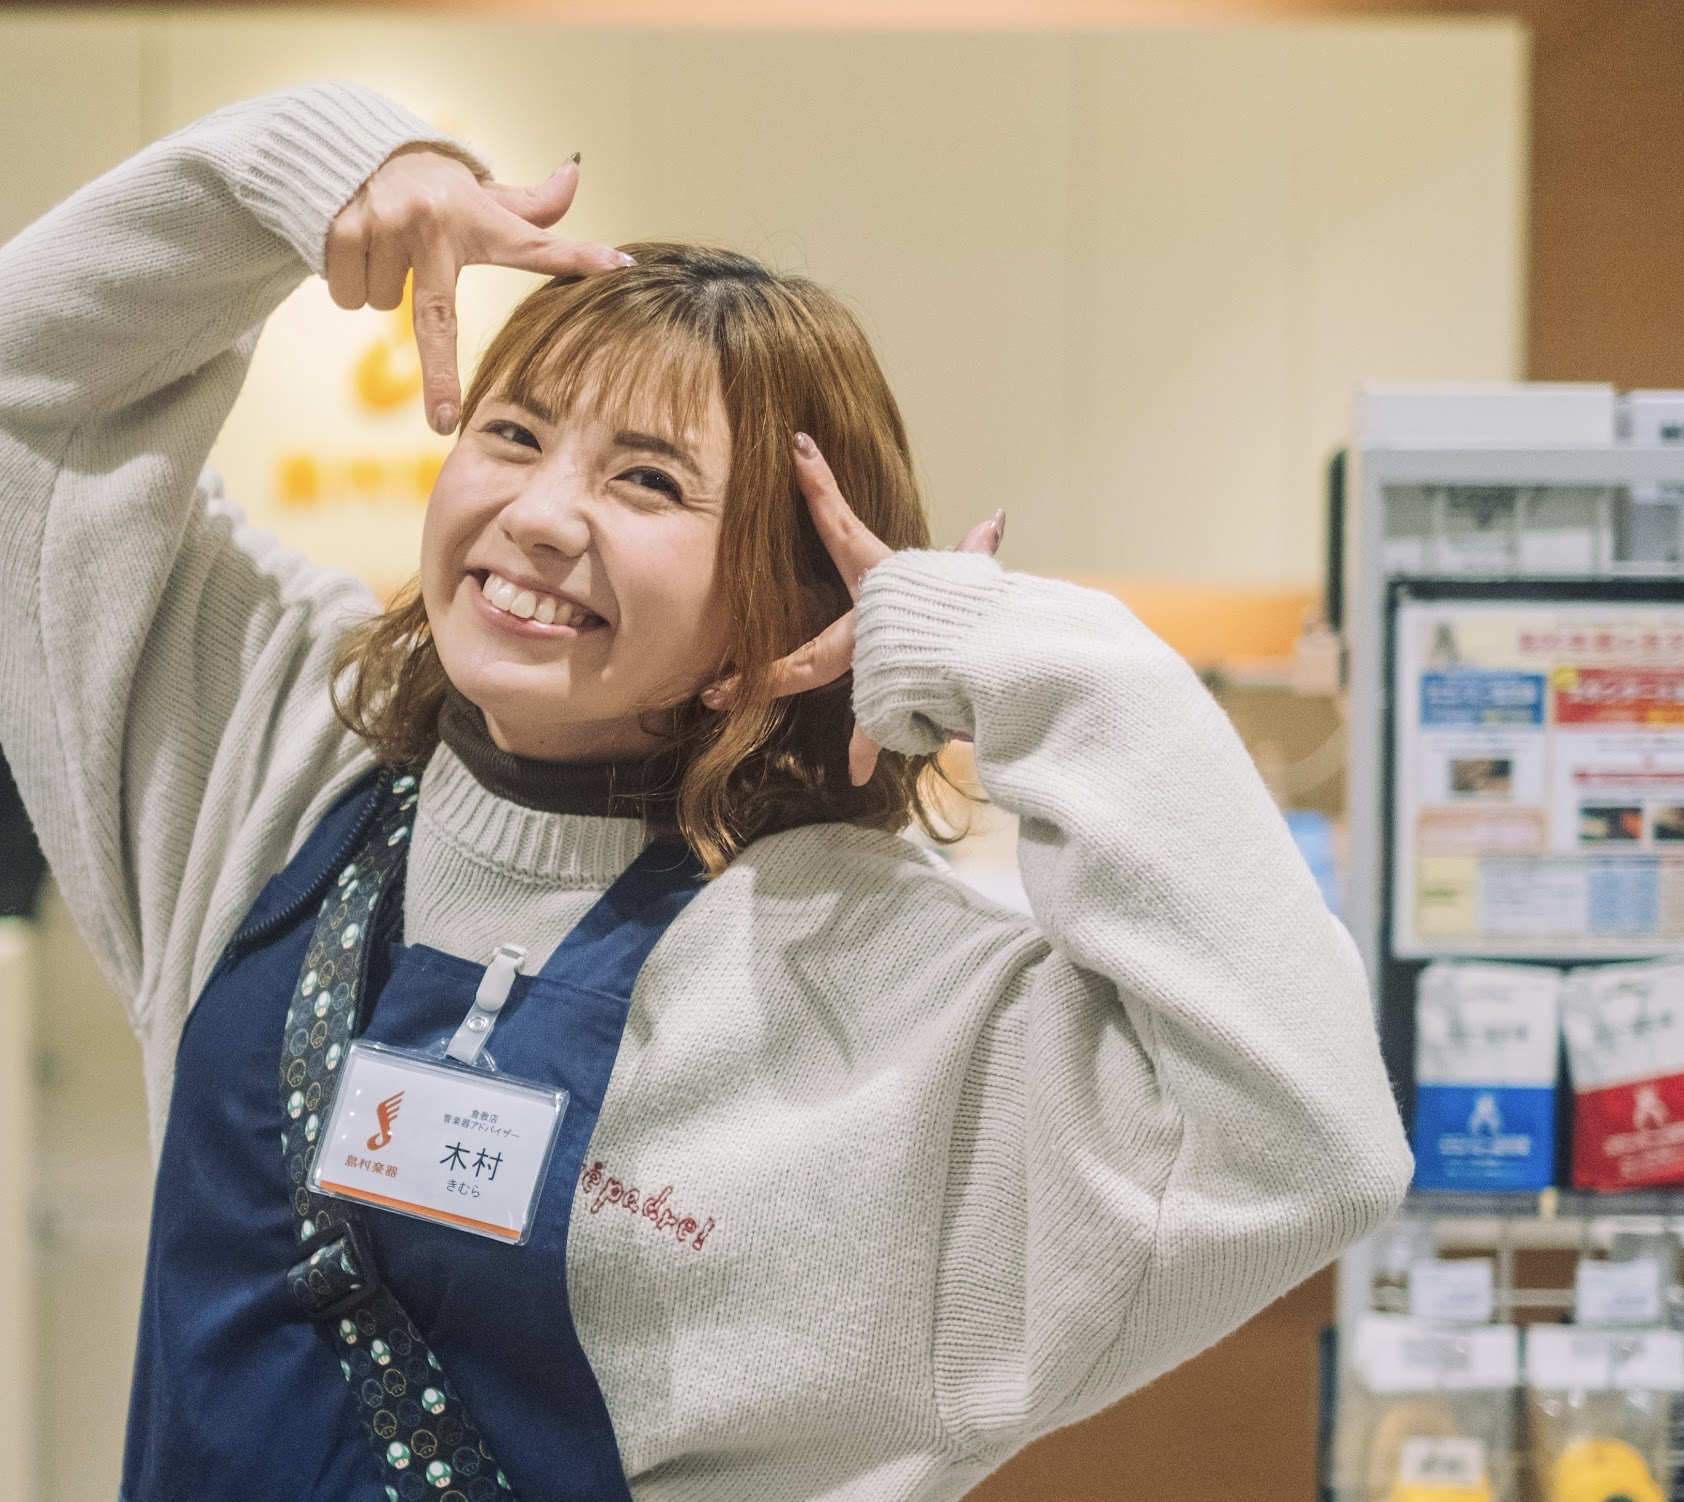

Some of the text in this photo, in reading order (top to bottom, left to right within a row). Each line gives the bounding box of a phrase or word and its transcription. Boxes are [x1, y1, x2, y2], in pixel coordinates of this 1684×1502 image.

[443, 1113, 520, 1138] 管楽器アドバイザー
[470, 1109, 499, 1124] 倉敷店
[344, 1154, 398, 1178] 島村楽器
[439, 1141, 504, 1181] 木村
[446, 1178, 481, 1198] きむら
